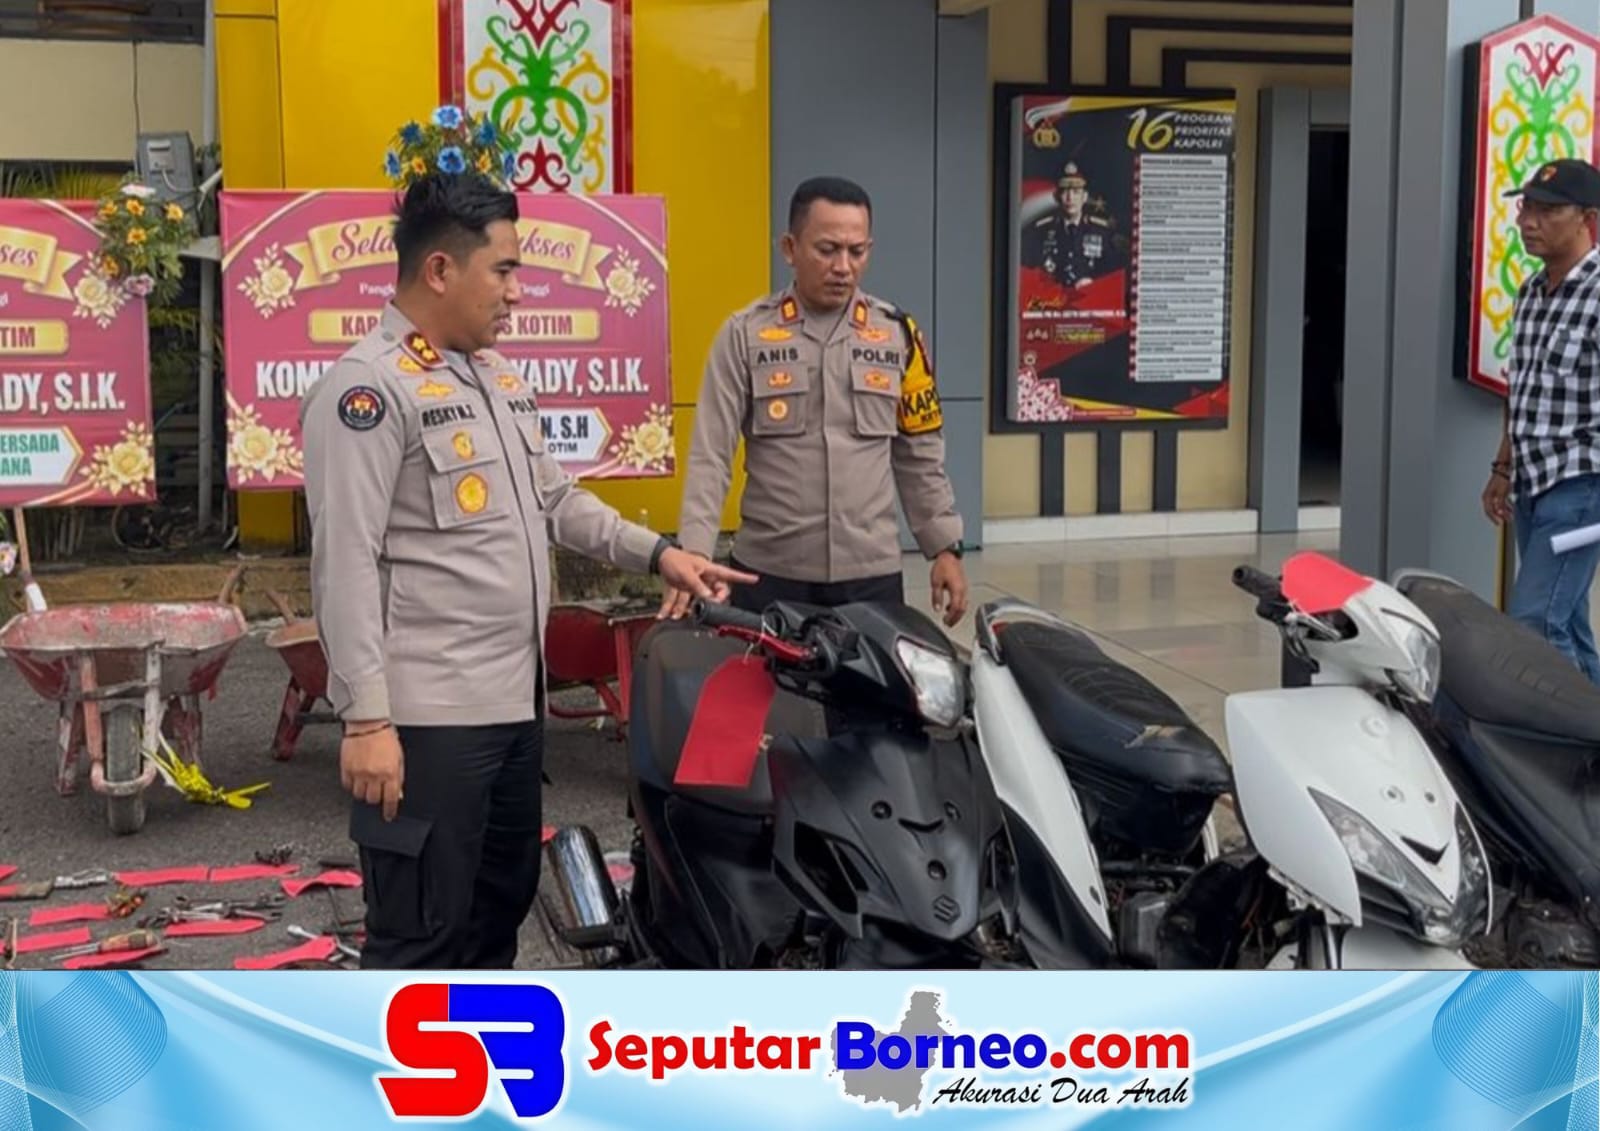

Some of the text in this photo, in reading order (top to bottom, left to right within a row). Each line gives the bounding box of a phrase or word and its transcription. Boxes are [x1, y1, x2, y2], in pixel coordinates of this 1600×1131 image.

[1174, 112, 1232, 124] PROGRAM
[1127, 106, 1178, 151] 16
[1174, 126, 1232, 137] PRIORITAS
[1174, 138, 1222, 149] KAPOLRI
[517, 315, 573, 336] KOTIM
[757, 348, 799, 364] ANIS
[852, 349, 900, 365] POLRI
[588, 357, 649, 395] S.I.K.
[0, 372, 126, 415] DY, S.I.K.
[560, 415, 589, 439] S.H
